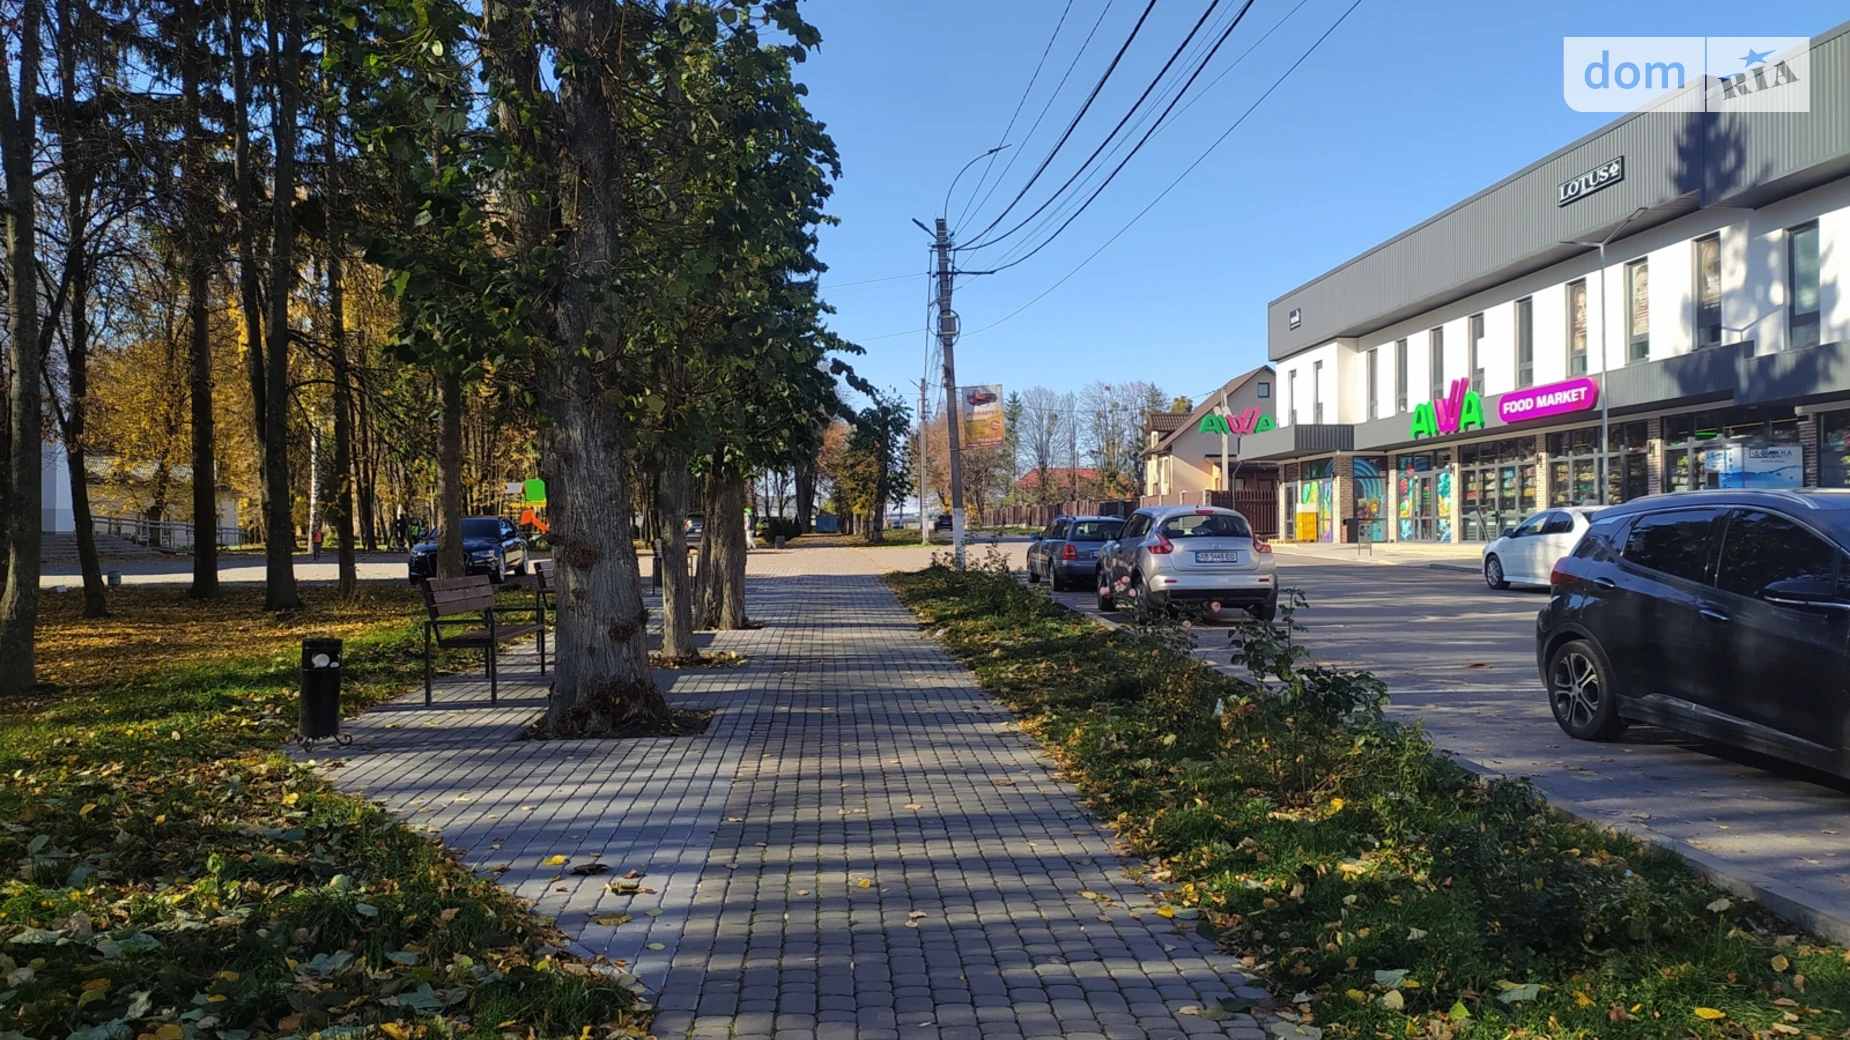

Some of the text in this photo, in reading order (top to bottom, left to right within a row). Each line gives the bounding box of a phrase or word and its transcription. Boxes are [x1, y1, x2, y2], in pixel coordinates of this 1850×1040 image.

[1559, 165, 1609, 201] LOTUS
[1503, 387, 1588, 414] FOOD MARKET
